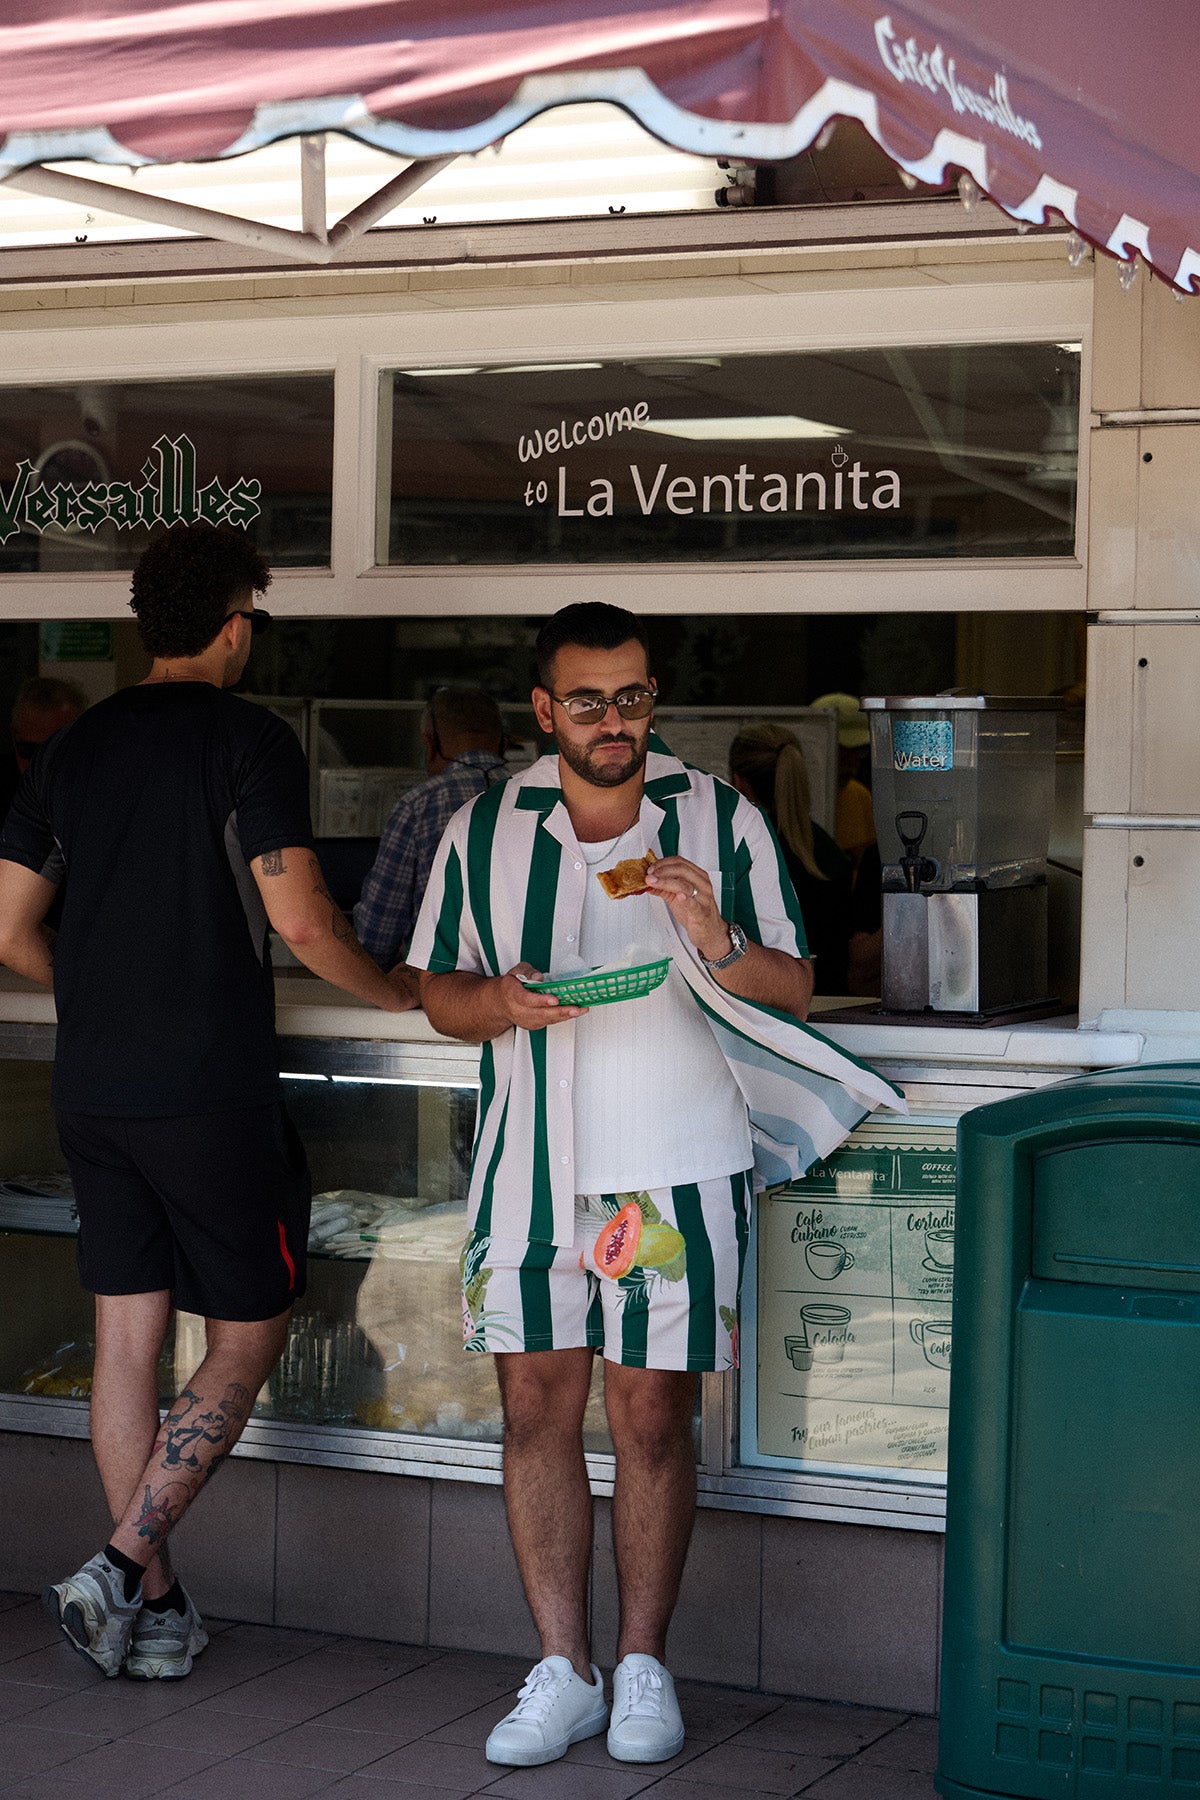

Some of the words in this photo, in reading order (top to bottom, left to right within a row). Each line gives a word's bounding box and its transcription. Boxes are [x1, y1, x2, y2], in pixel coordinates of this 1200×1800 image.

[930, 44, 1042, 151] Versailles
[523, 480, 548, 507] to
[558, 467, 614, 517] La
[630, 460, 901, 516] Ventanita
[895, 751, 948, 768] Water
[812, 1167, 826, 1178] La
[828, 1167, 886, 1182] Ventanita
[921, 1162, 953, 1172] COFFEE
[791, 1225, 838, 1243] Cubano
[812, 1328, 857, 1347] Colada
[791, 1426, 808, 1443] Try
[813, 1420, 832, 1435] our
[835, 1408, 875, 1430] famous
[808, 1432, 841, 1450] Cuban
[152, 1618, 166, 1626] NB
